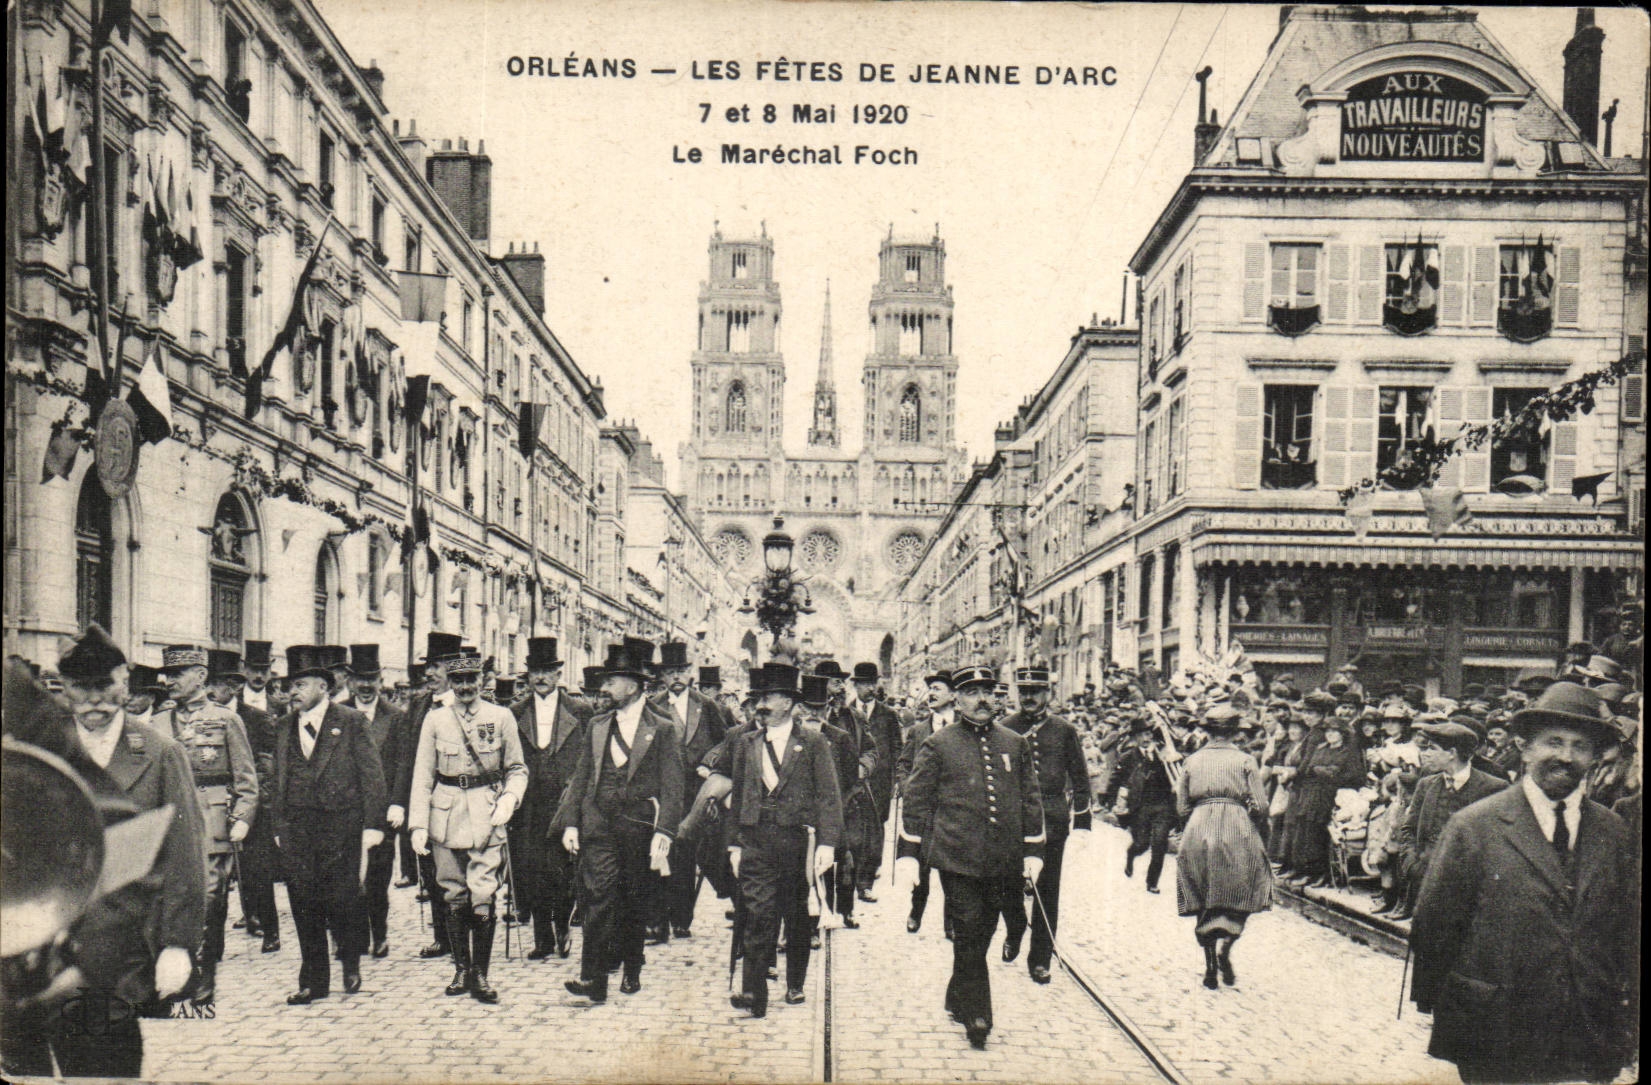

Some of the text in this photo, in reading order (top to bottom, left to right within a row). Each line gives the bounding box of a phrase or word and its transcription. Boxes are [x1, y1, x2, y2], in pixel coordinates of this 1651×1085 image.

[1382, 74, 1444, 94] AUX
[1343, 97, 1483, 129] TRAVAILLEURS
[1342, 131, 1482, 158] NOUVEAUTÉS
